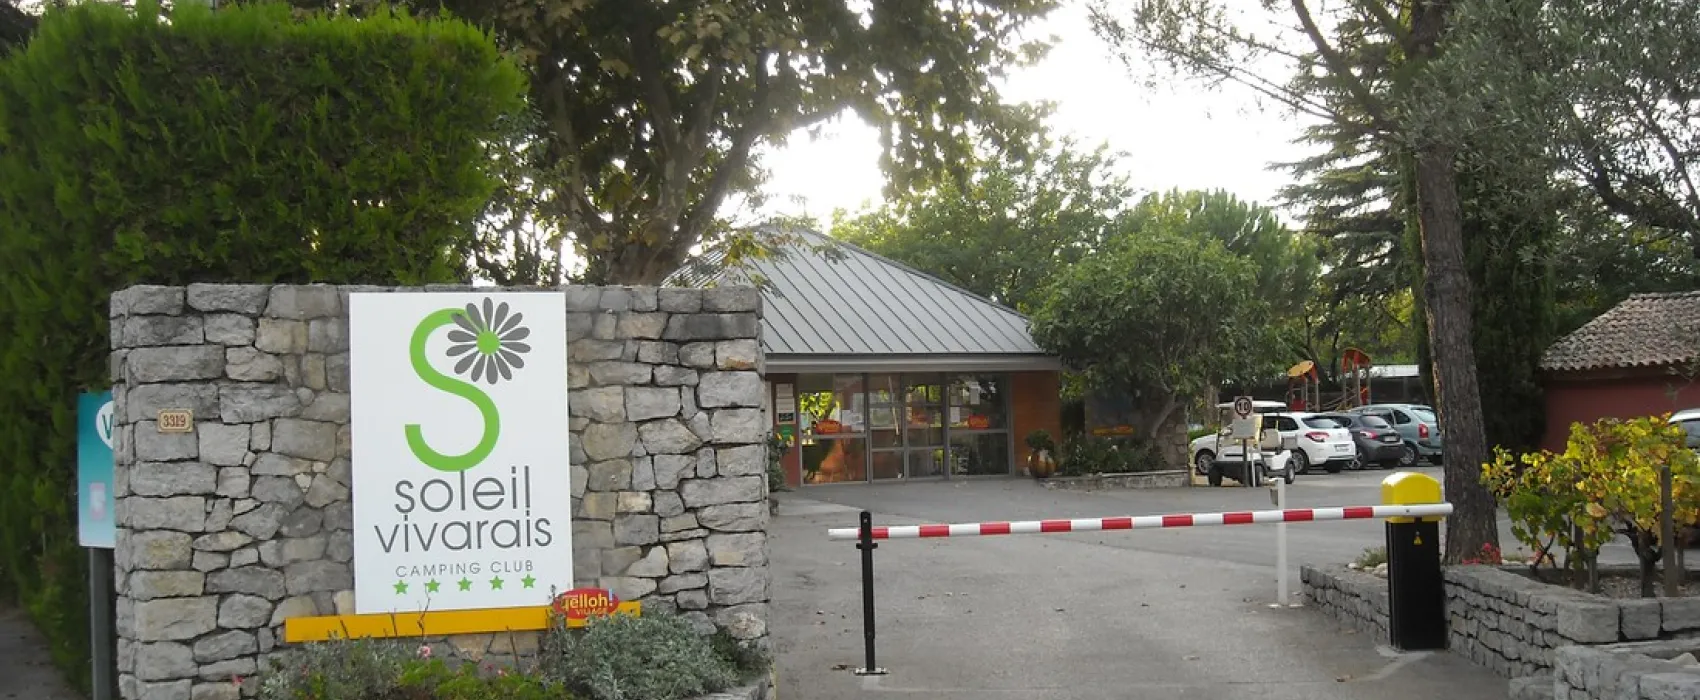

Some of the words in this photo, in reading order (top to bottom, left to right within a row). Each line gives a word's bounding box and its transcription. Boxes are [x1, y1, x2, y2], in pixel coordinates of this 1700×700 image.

[1237, 401, 1250, 412] 10
[163, 414, 186, 428] 3319
[394, 465, 531, 514] soleil
[374, 510, 553, 554] vivarais
[395, 562, 482, 578] CAMPING
[490, 559, 534, 573] CLUB
